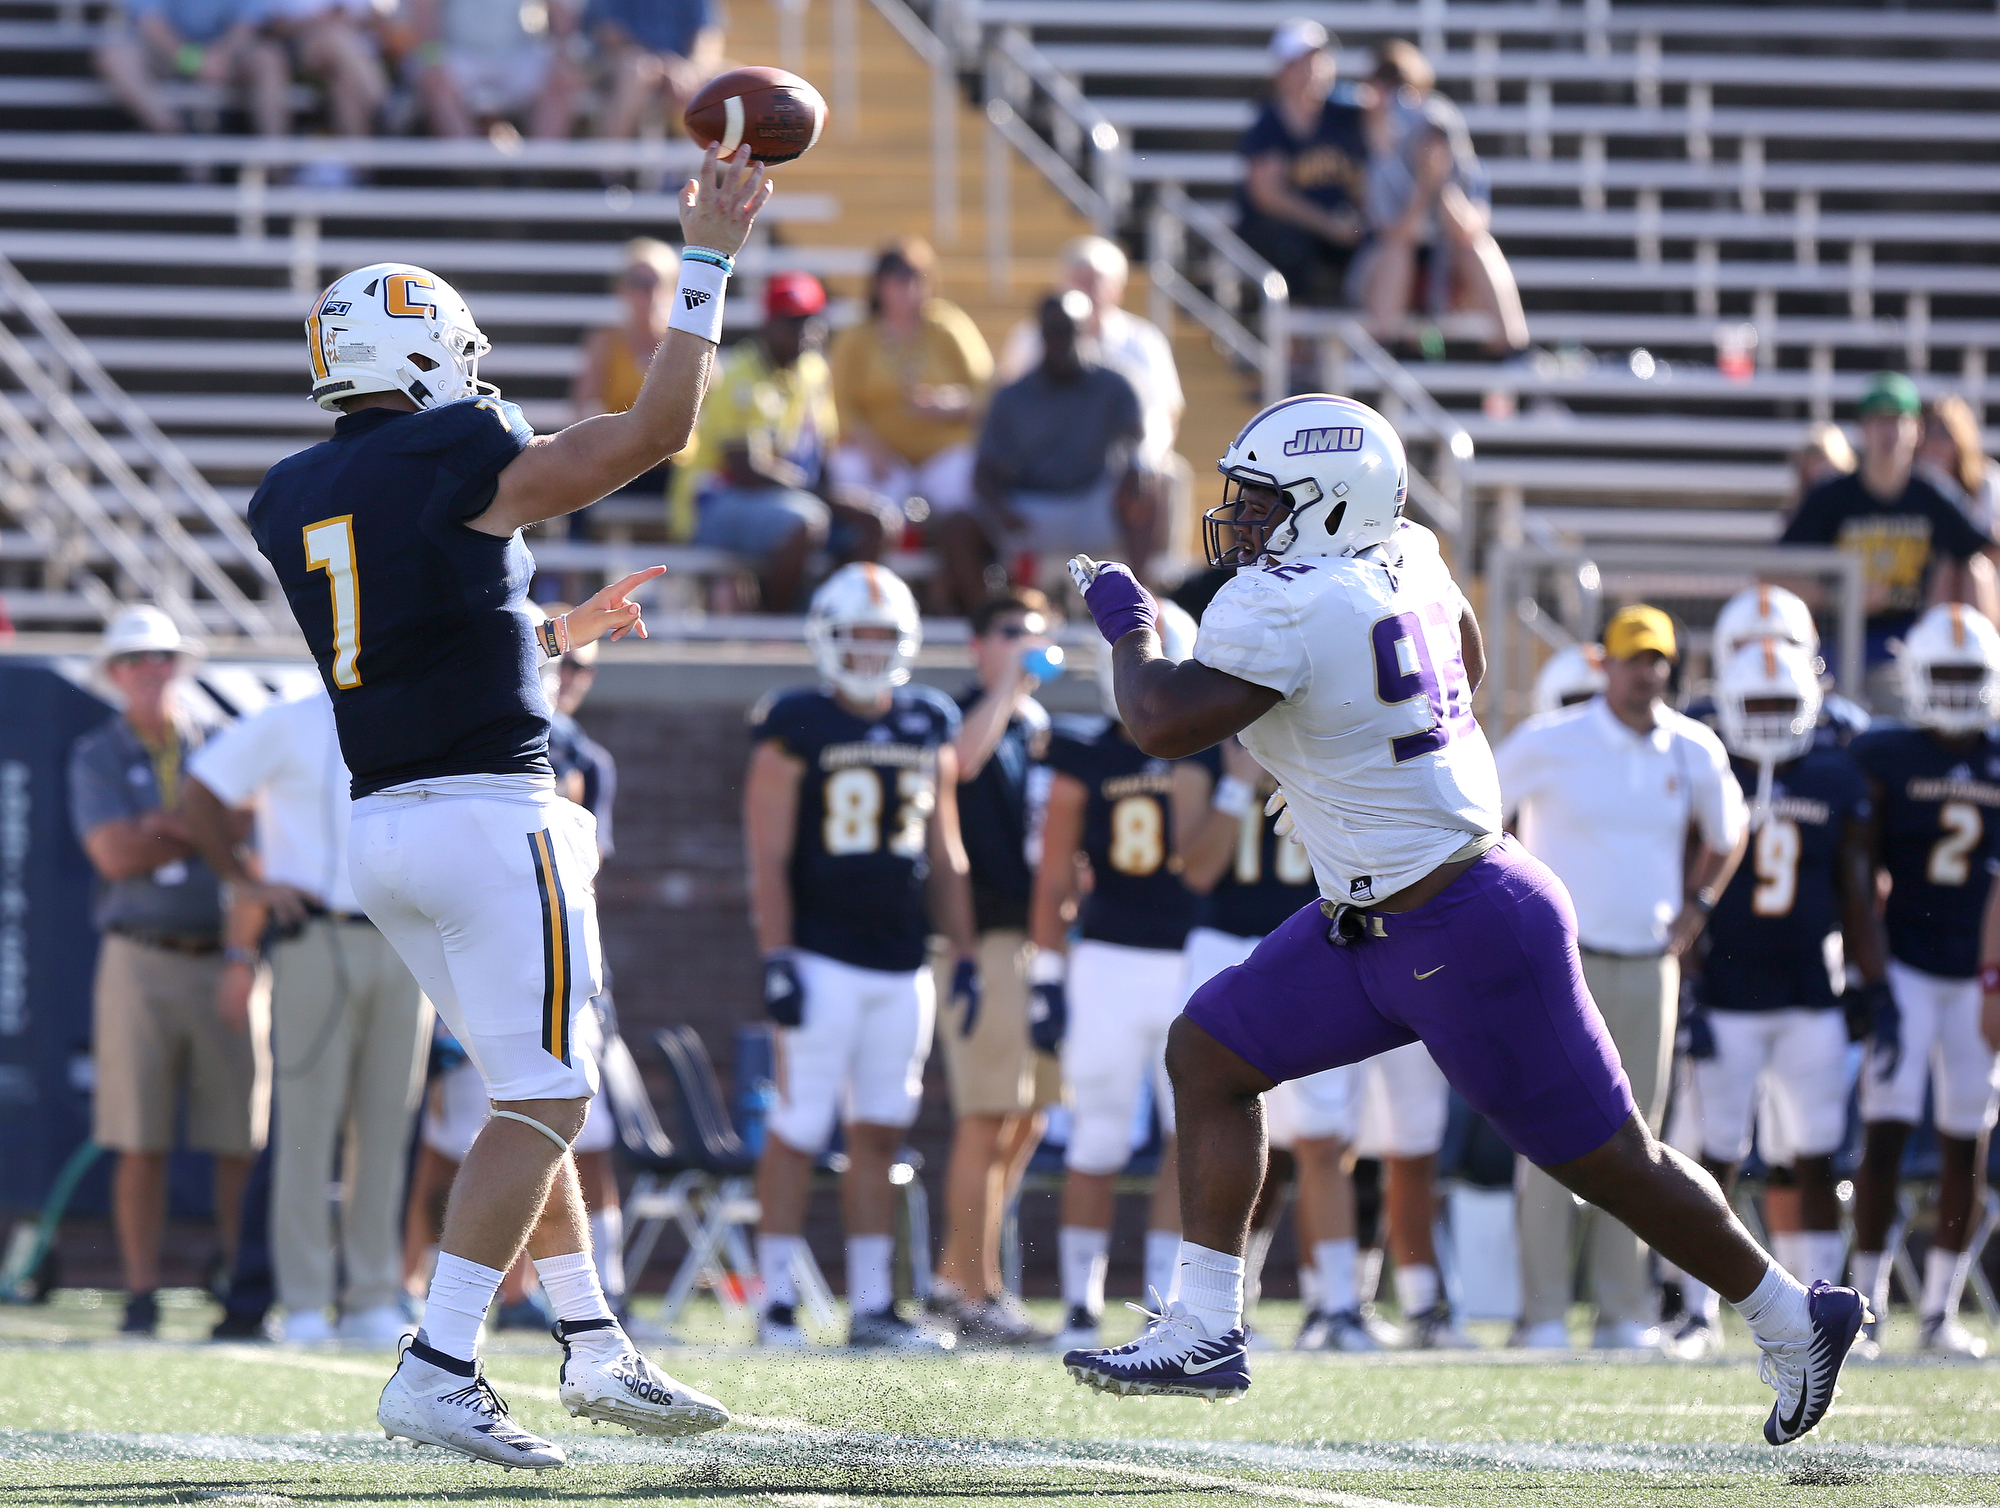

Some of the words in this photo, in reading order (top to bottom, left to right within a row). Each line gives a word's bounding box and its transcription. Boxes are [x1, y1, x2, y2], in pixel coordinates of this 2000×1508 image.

[384, 273, 437, 320] C
[682, 288, 711, 300] adidas
[1283, 427, 1364, 457] JMU
[1926, 799, 1984, 887] 2
[1355, 880, 1368, 890] XL
[1752, 817, 1802, 918] 9
[612, 1367, 674, 1406] adidas
